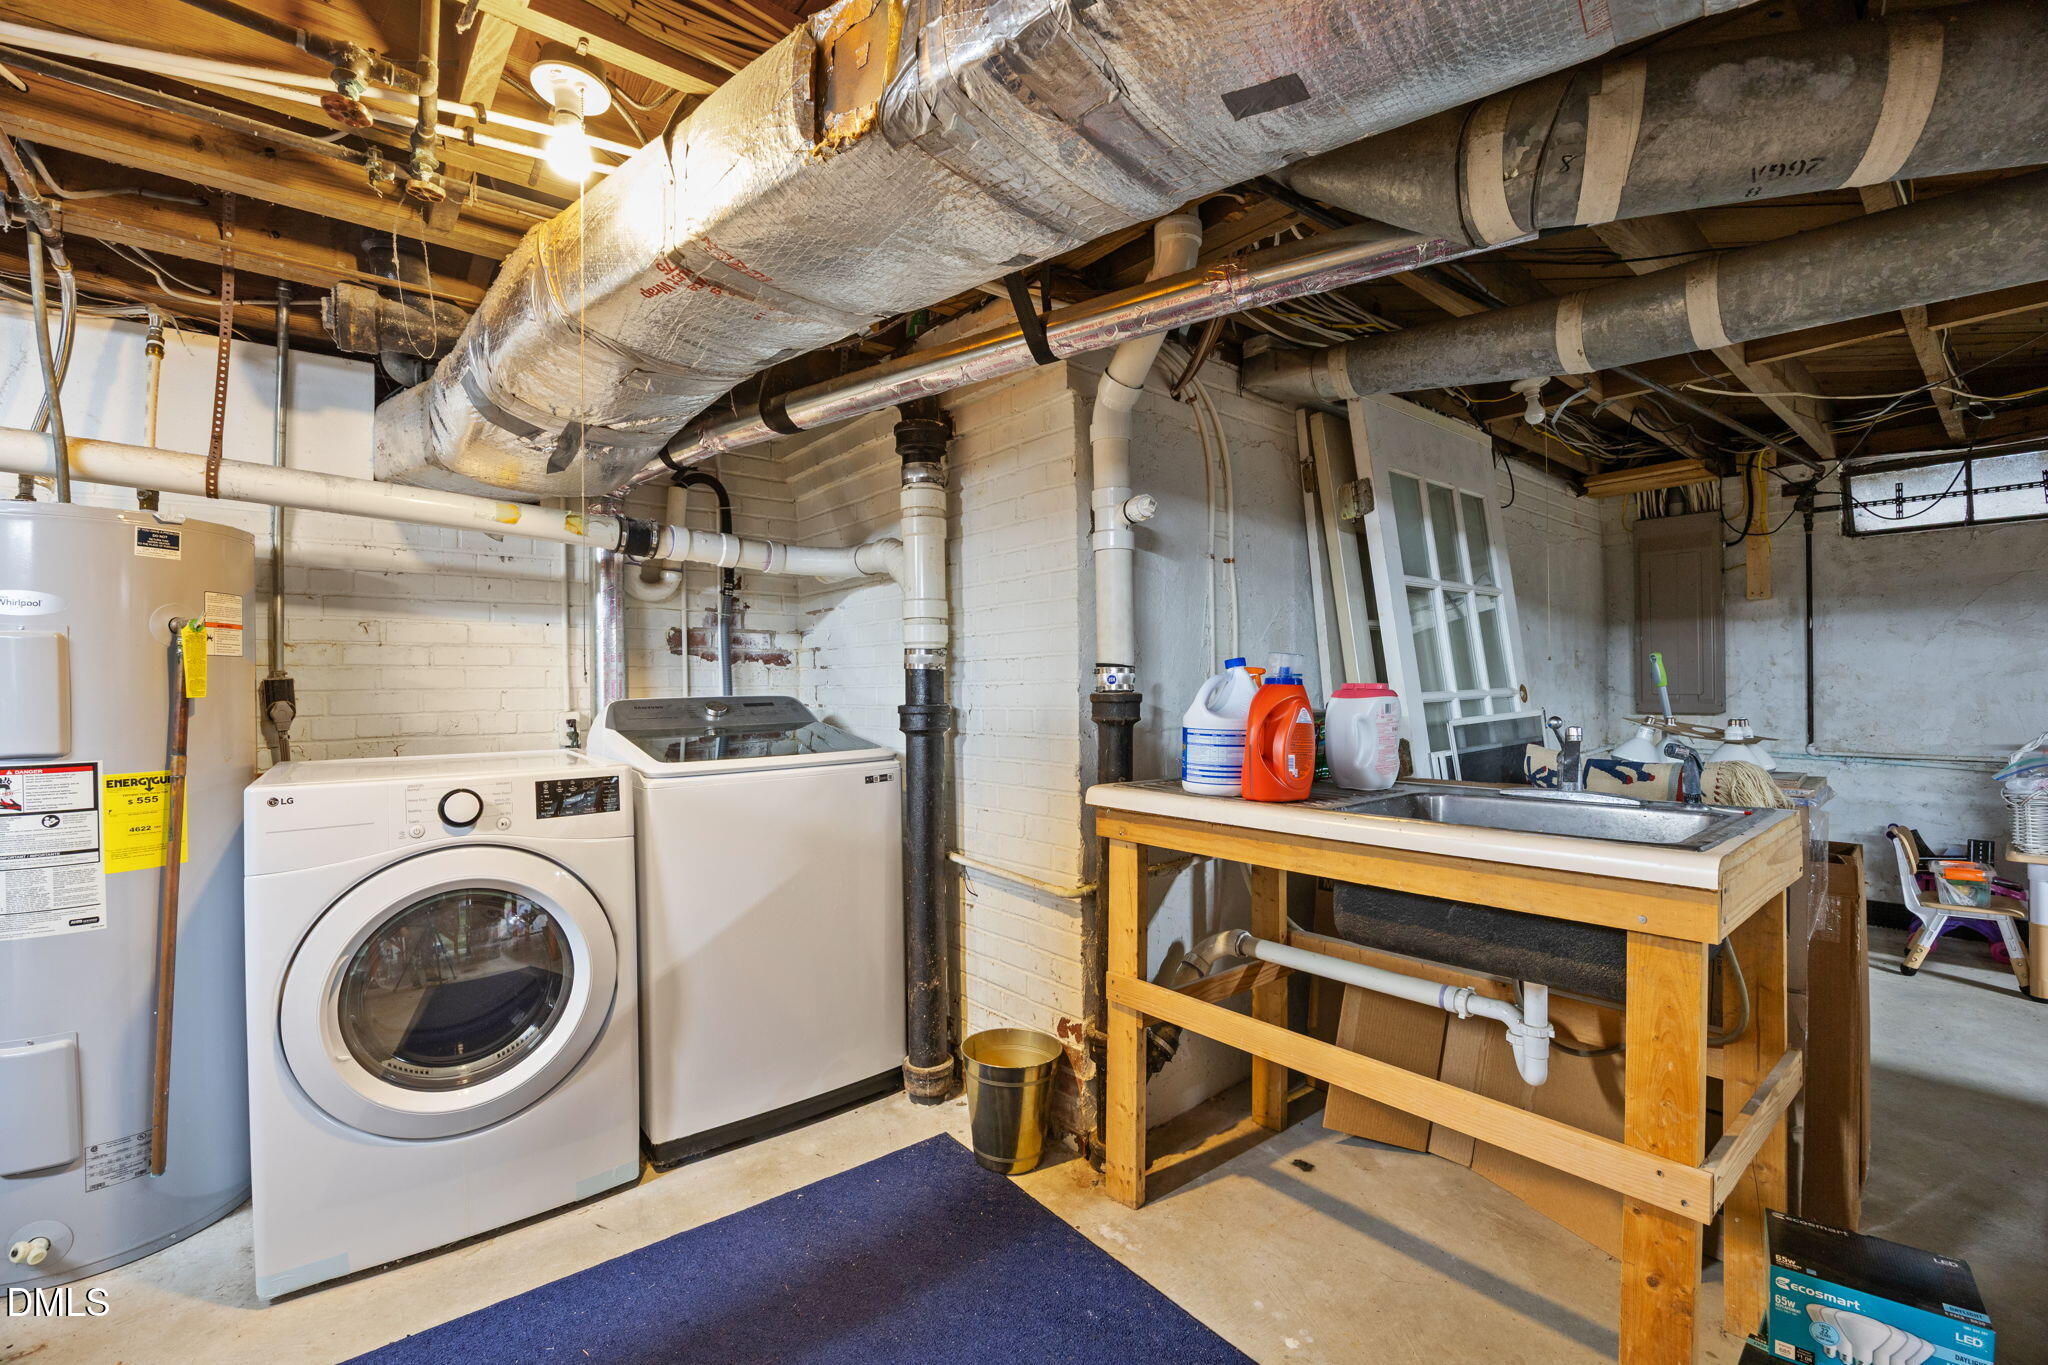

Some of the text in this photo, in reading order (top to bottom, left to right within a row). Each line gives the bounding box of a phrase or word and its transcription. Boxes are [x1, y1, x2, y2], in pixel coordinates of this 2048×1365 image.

[137, 796, 159, 804] 555
[280, 797, 294, 805] LG
[1785, 1215, 1850, 1237] ecosmart
[1932, 1256, 1960, 1269] LED
[1790, 1283, 1861, 1311] ecosmart
[1955, 1332, 1984, 1348] LED
